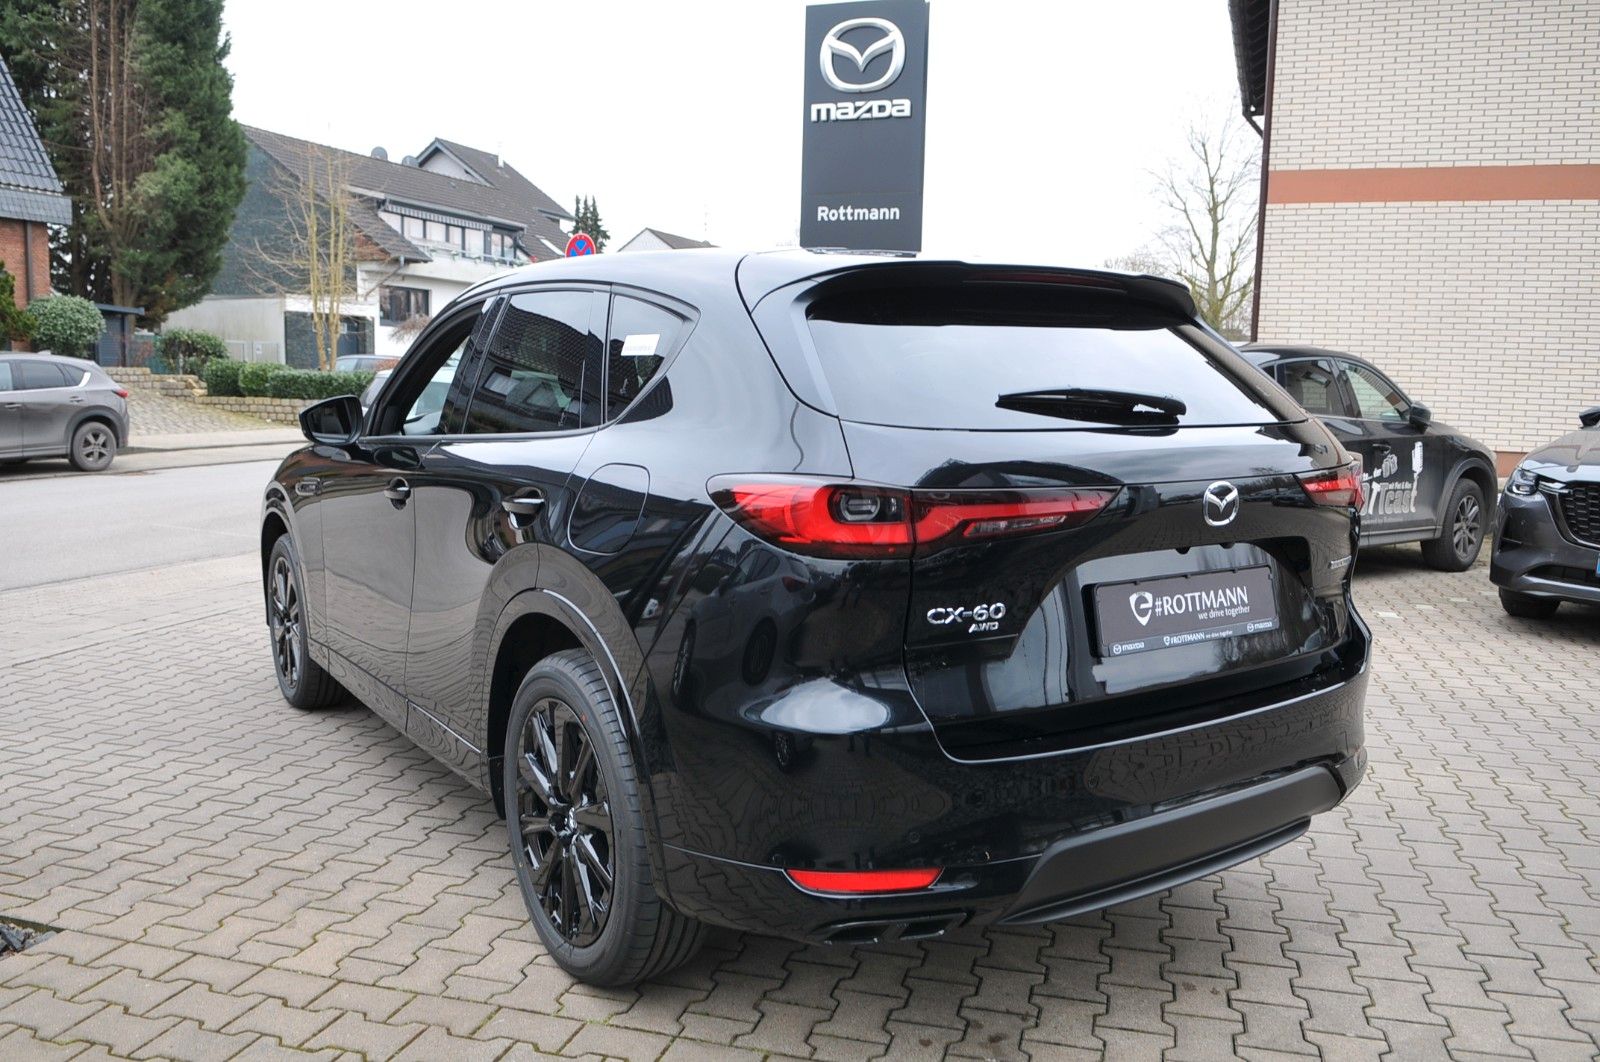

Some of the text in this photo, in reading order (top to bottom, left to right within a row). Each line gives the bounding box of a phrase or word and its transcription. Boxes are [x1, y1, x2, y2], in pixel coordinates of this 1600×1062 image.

[817, 205, 900, 222] Rottmann
[1155, 585, 1249, 617] #ROTTMANN
[926, 602, 1006, 625] CX-60
[1198, 605, 1250, 620] we drive together
[968, 621, 999, 633] AWD
